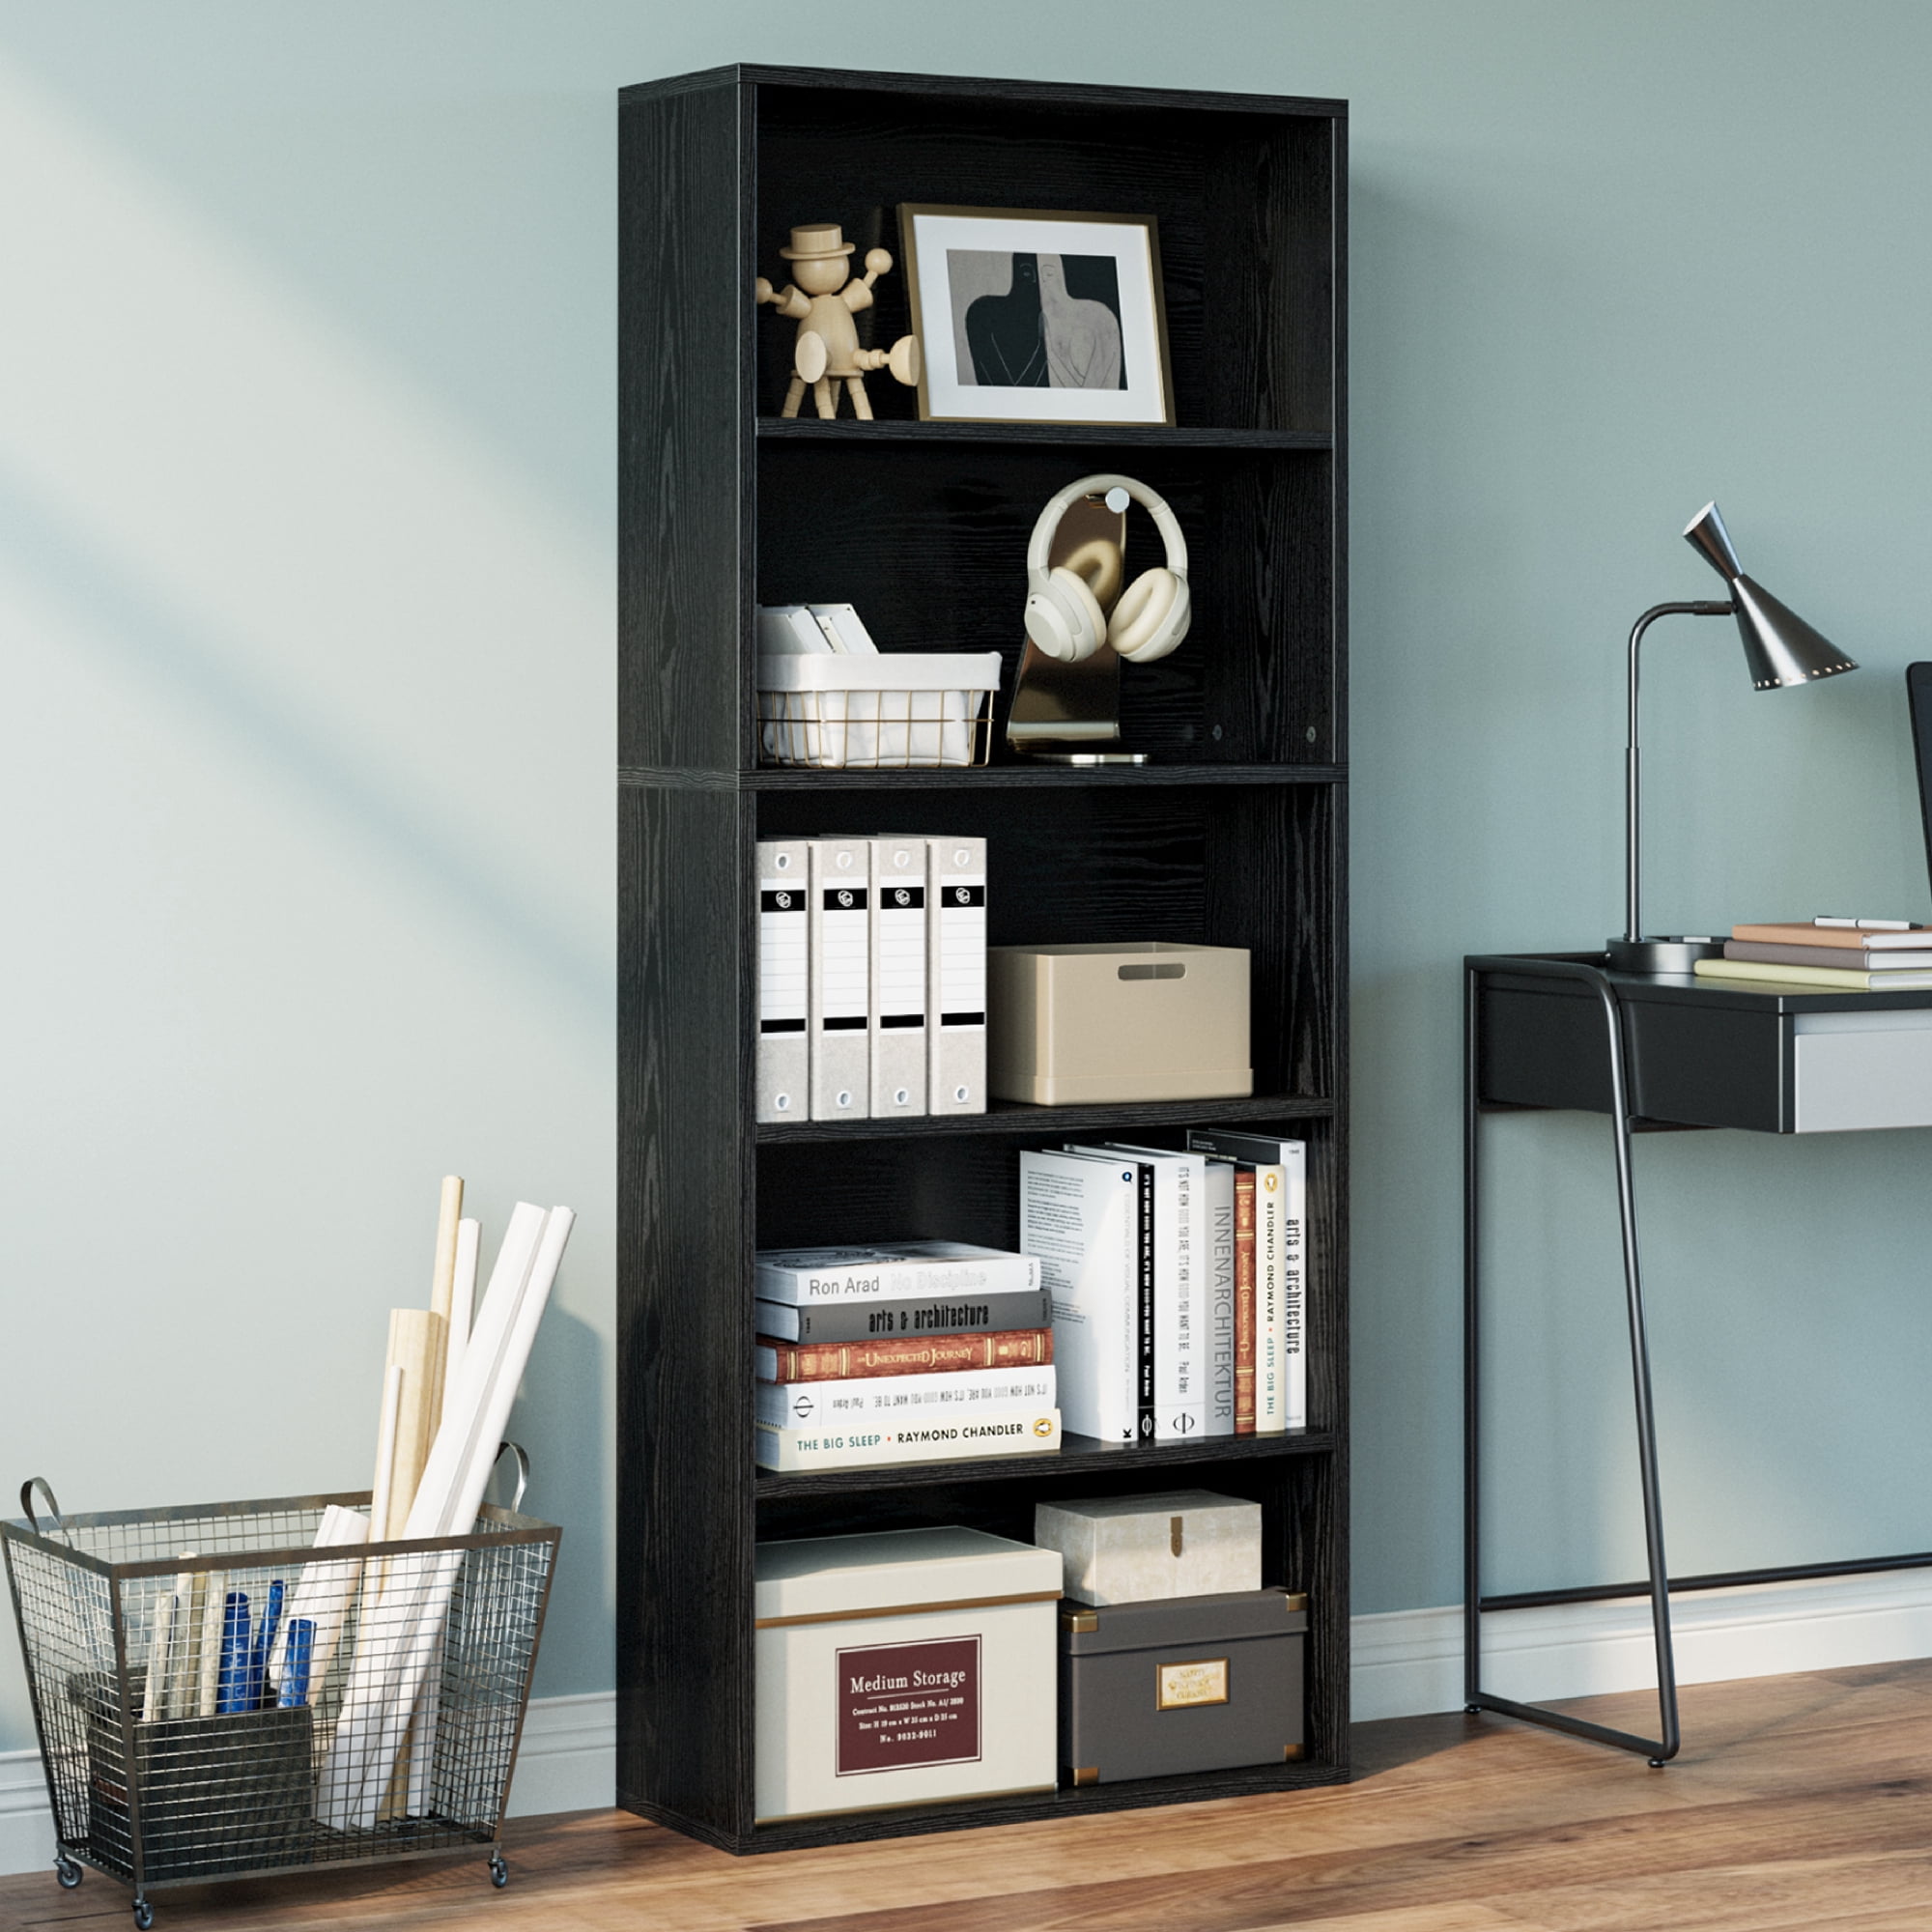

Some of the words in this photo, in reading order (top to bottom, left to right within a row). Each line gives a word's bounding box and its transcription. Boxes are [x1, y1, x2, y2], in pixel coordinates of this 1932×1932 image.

[1266, 1202, 1275, 1261] CHANDLER
[1286, 1219, 1301, 1246] arts
[809, 1279, 839, 1296] Ron
[844, 1276, 880, 1293] Arad
[891, 1272, 912, 1292] No
[918, 1268, 987, 1291] Discipline
[1266, 1264, 1275, 1322] RAYMOND
[868, 1309, 894, 1333] arts
[914, 1303, 989, 1329] architecture
[1214, 1207, 1232, 1418] INNENARCHITEKTUR
[1286, 1270, 1302, 1354] architecture
[866, 1351, 929, 1367] UNEXPECTED
[928, 1348, 973, 1367] JOURNEY
[1266, 1338, 1275, 1367] SLEEP
[1266, 1373, 1275, 1391] BIG
[1266, 1397, 1275, 1415] THE
[797, 1439, 819, 1451] THE
[823, 1436, 844, 1449] BIG
[848, 1435, 881, 1448] SLEEP
[897, 1430, 958, 1444] RAYMOND
[962, 1424, 1024, 1438] CHANDLER
[850, 1674, 908, 1693] Medium
[913, 1669, 966, 1689] Storage
